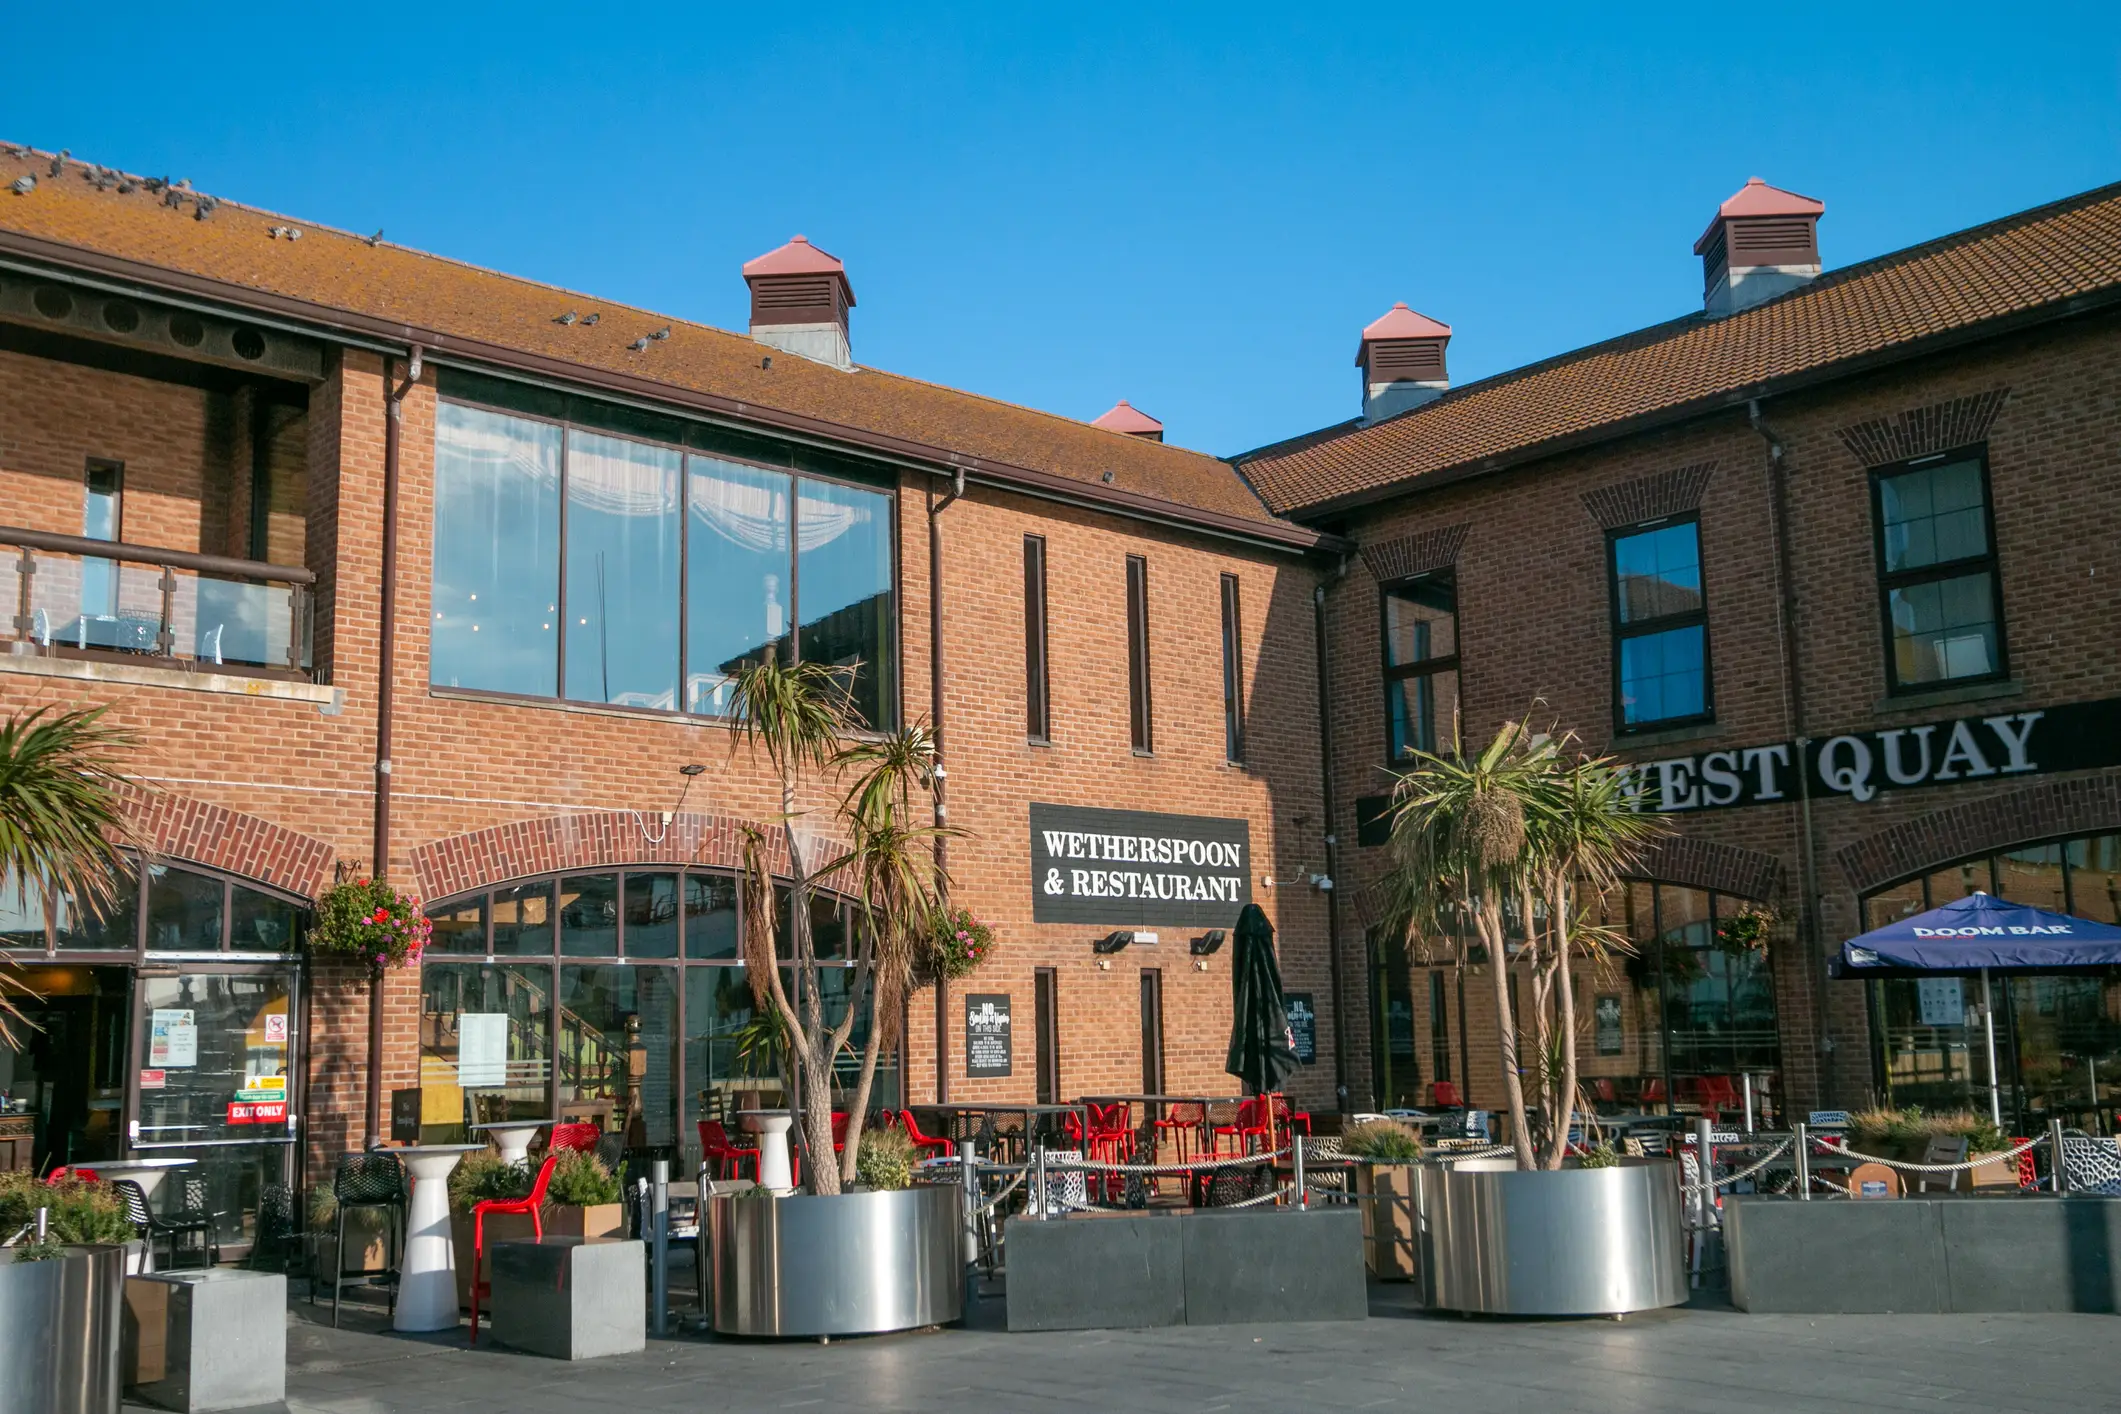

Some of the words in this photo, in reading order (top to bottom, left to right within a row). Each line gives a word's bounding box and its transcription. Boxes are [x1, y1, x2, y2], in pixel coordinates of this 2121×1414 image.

[1818, 711, 2044, 801] QUAY
[1042, 831, 1241, 868] WETHERSPOON
[1043, 867, 1064, 895] &
[1071, 869, 1241, 902] RESTAURANT
[1912, 926, 2006, 936] DOOM
[981, 1003, 994, 1015] NO
[232, 1107, 254, 1118] EXIT
[256, 1105, 283, 1117] ONLY
